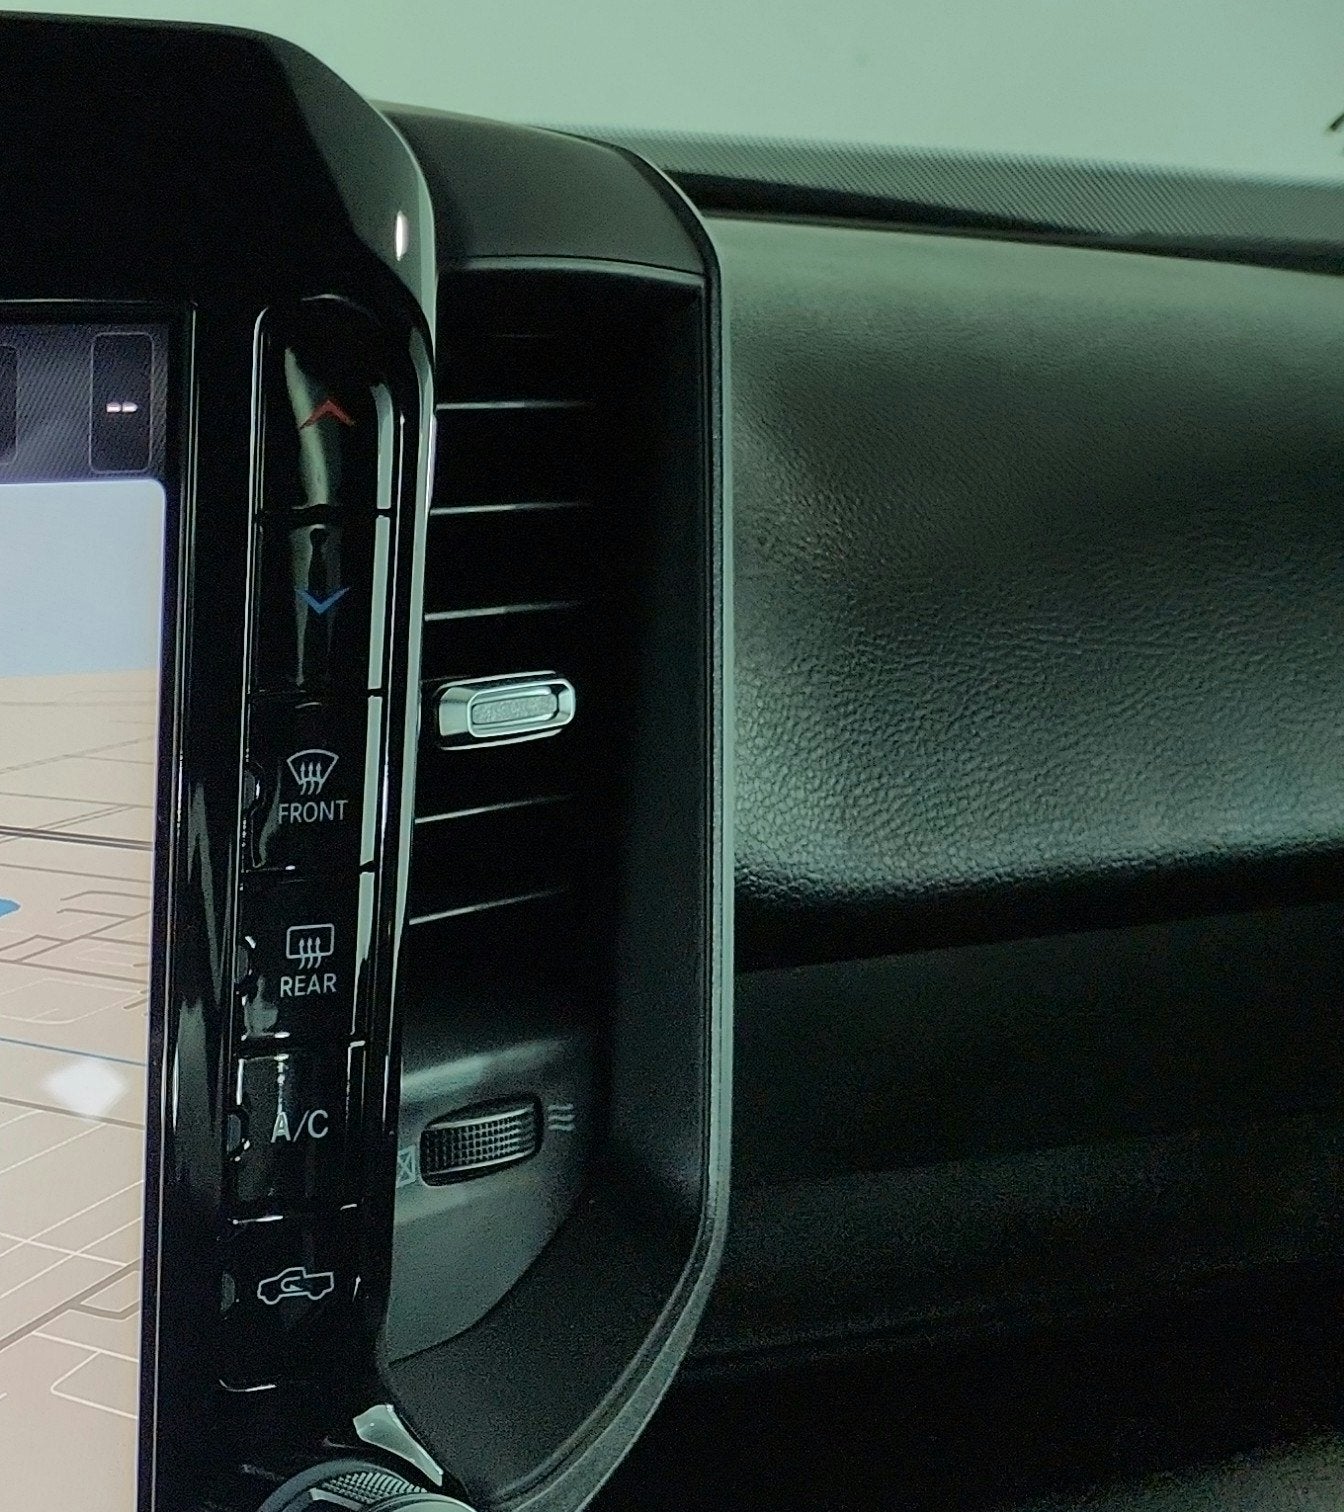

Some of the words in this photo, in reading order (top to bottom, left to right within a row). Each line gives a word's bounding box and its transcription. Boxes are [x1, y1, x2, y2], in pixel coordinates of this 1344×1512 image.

[278, 800, 348, 824] FRONT
[280, 973, 336, 997] REAR
[271, 1109, 329, 1143] A/C
